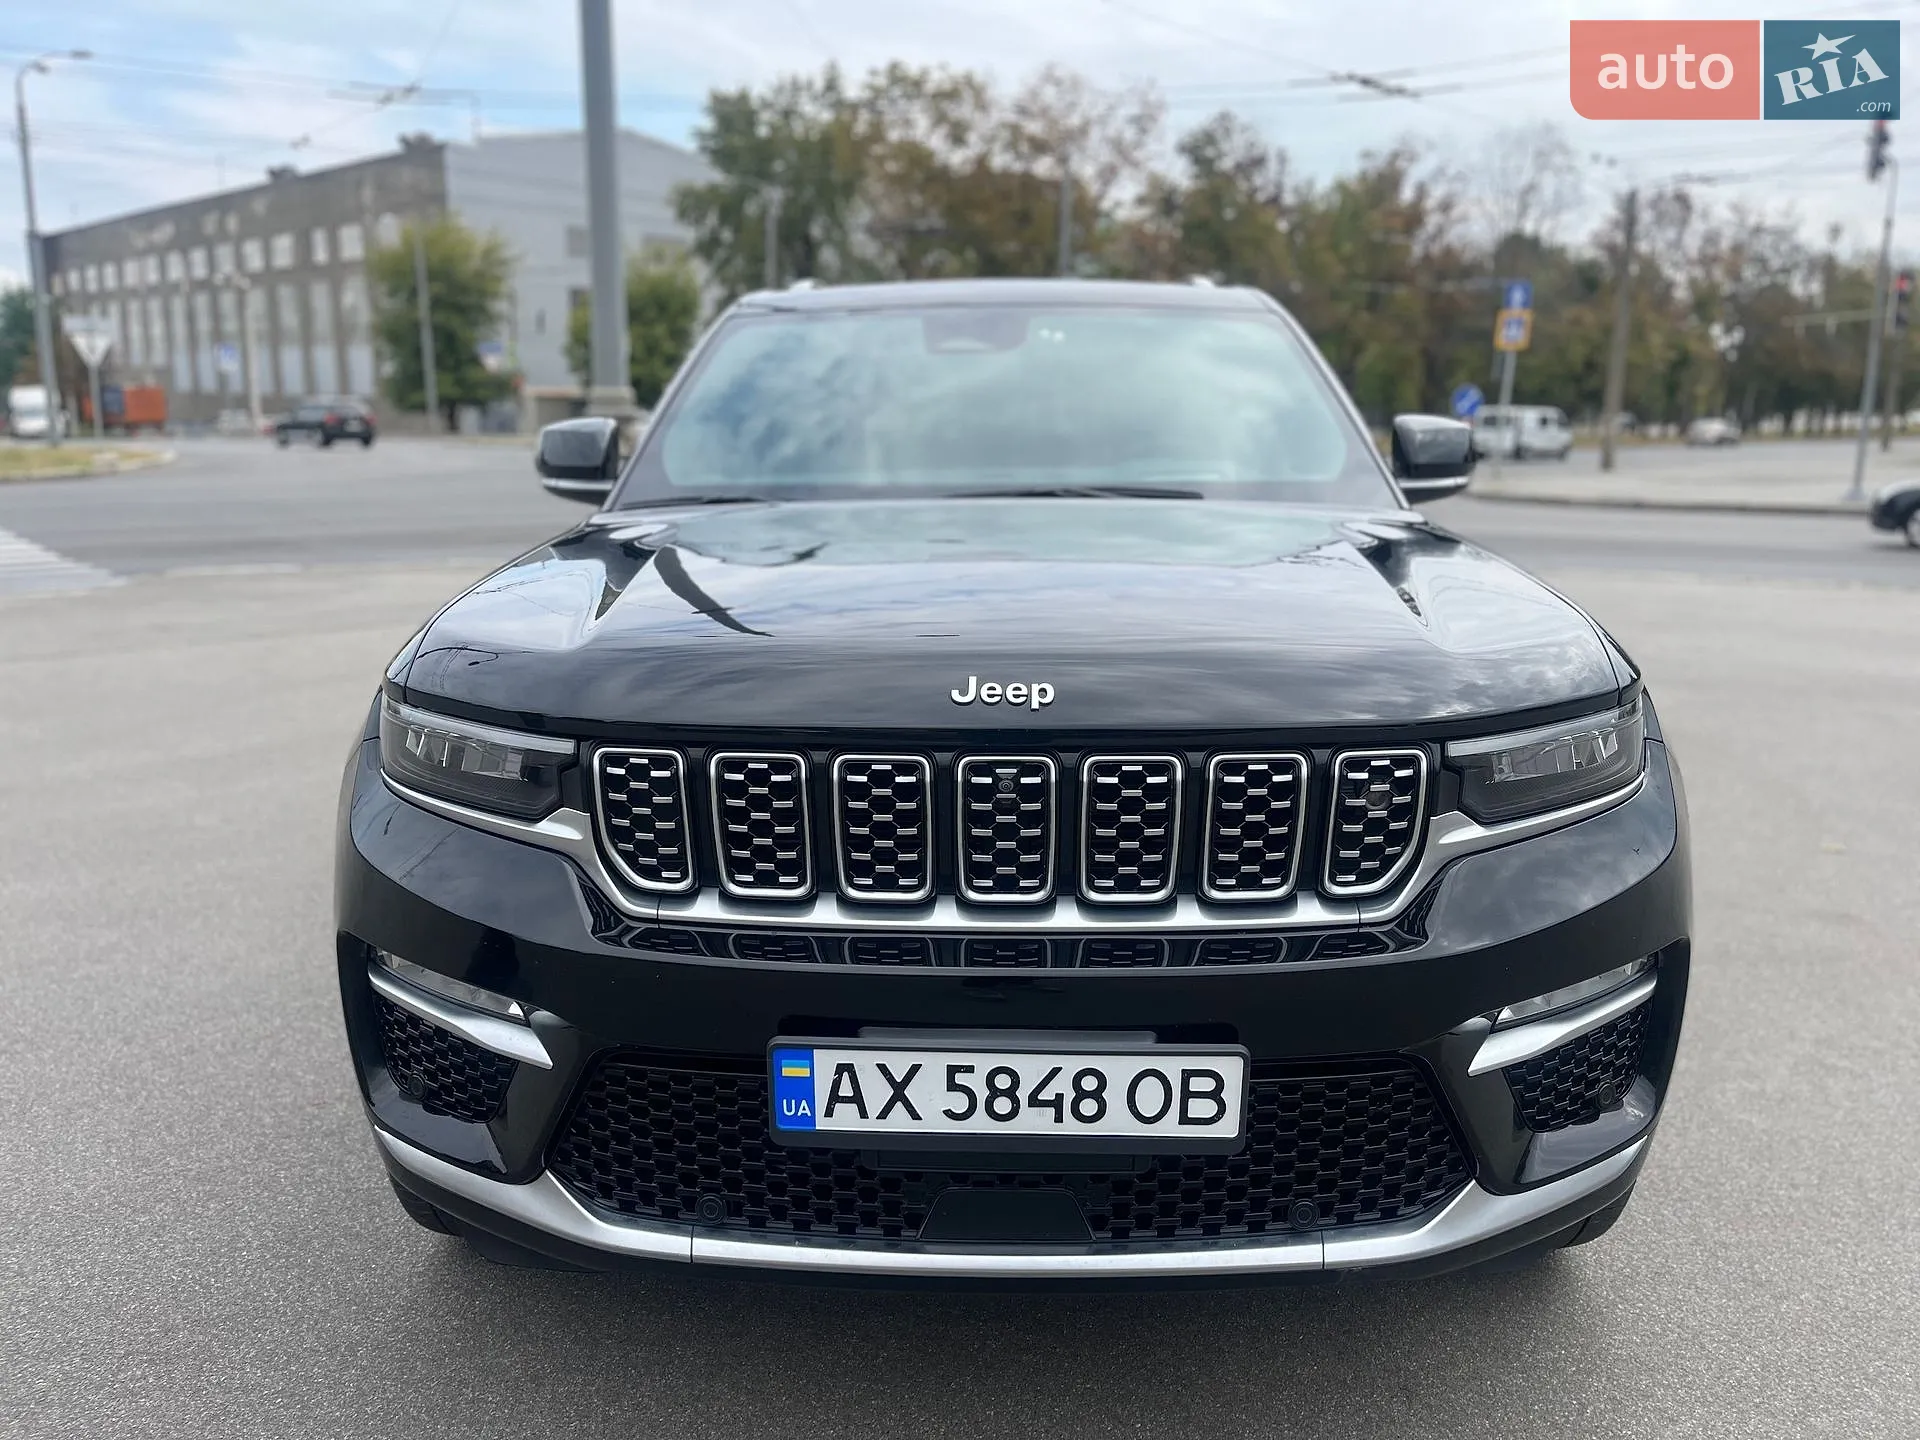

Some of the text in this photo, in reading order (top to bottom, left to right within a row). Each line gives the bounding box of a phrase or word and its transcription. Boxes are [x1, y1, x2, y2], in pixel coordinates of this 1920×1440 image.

[950, 675, 1056, 711] Jeep
[781, 1099, 812, 1117] UA
[823, 1062, 1227, 1126] AX 5848 OB
